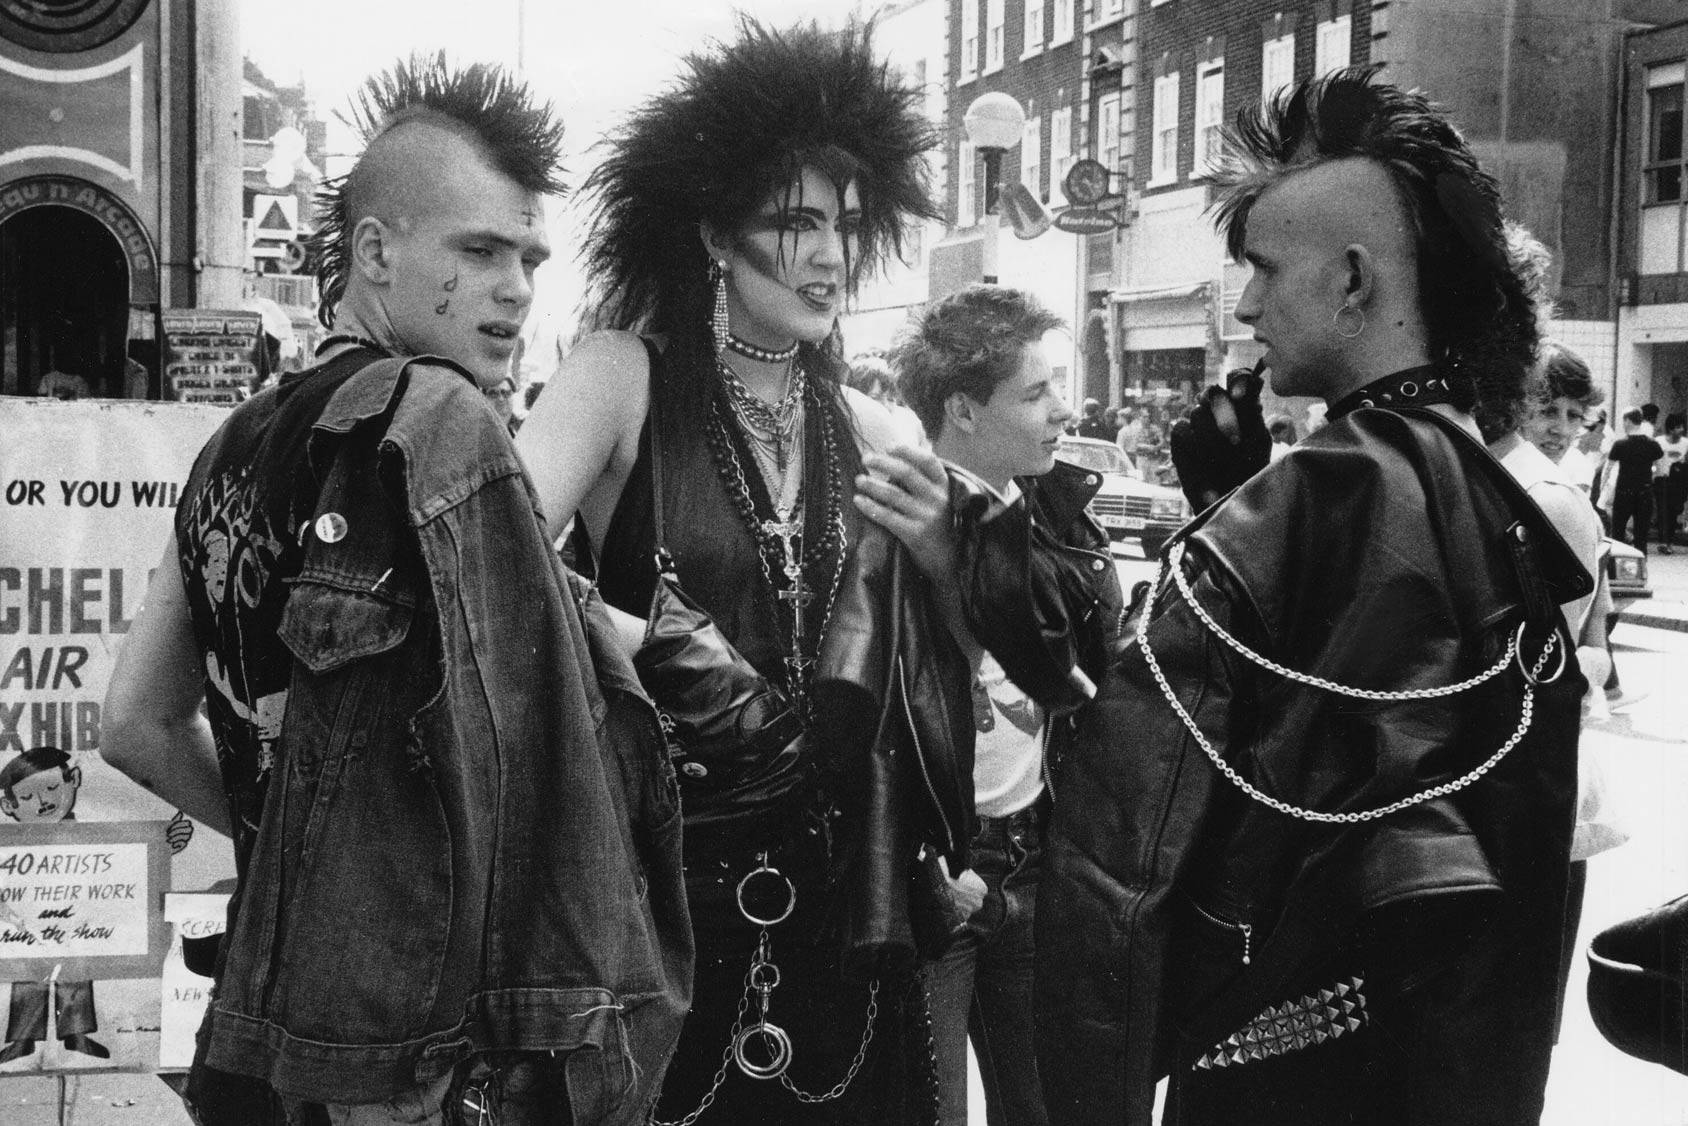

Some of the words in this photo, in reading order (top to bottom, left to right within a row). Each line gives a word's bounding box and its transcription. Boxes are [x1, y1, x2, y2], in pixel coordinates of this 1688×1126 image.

[75, 187, 150, 270] Arcade
[6, 480, 45, 506] OR
[60, 480, 121, 508] YOU
[0, 567, 156, 634] CHEL
[1, 646, 89, 690] AIR
[0, 852, 34, 875] 40
[36, 853, 114, 874] ARTISTS
[34, 885, 82, 902] THEIR
[88, 883, 136, 900] WORK
[38, 904, 75, 919] and
[0, 929, 36, 945] run
[41, 924, 66, 944] the
[71, 922, 115, 939] show
